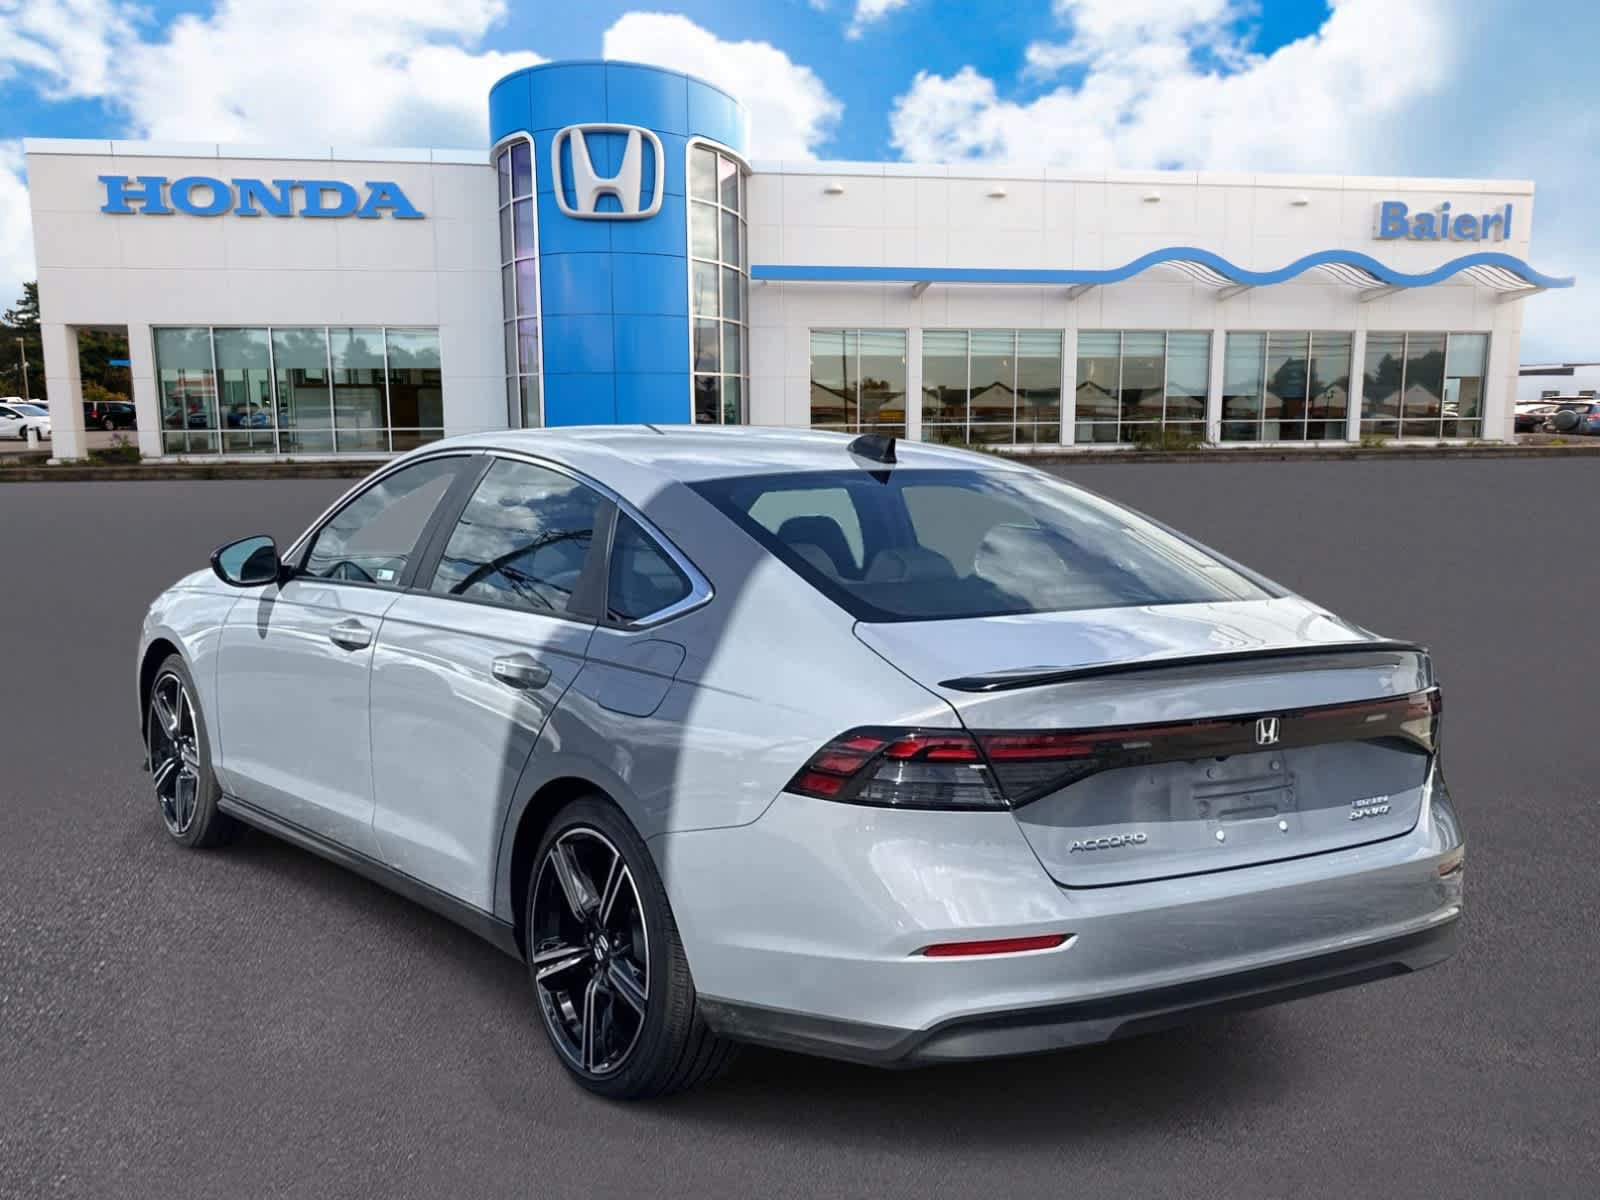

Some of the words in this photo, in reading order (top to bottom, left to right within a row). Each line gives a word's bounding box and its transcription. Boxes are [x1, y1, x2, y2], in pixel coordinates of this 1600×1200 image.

[98, 175, 425, 220] HONDA
[1379, 200, 1513, 240] Baierl
[1069, 832, 1148, 854] ACCORD
